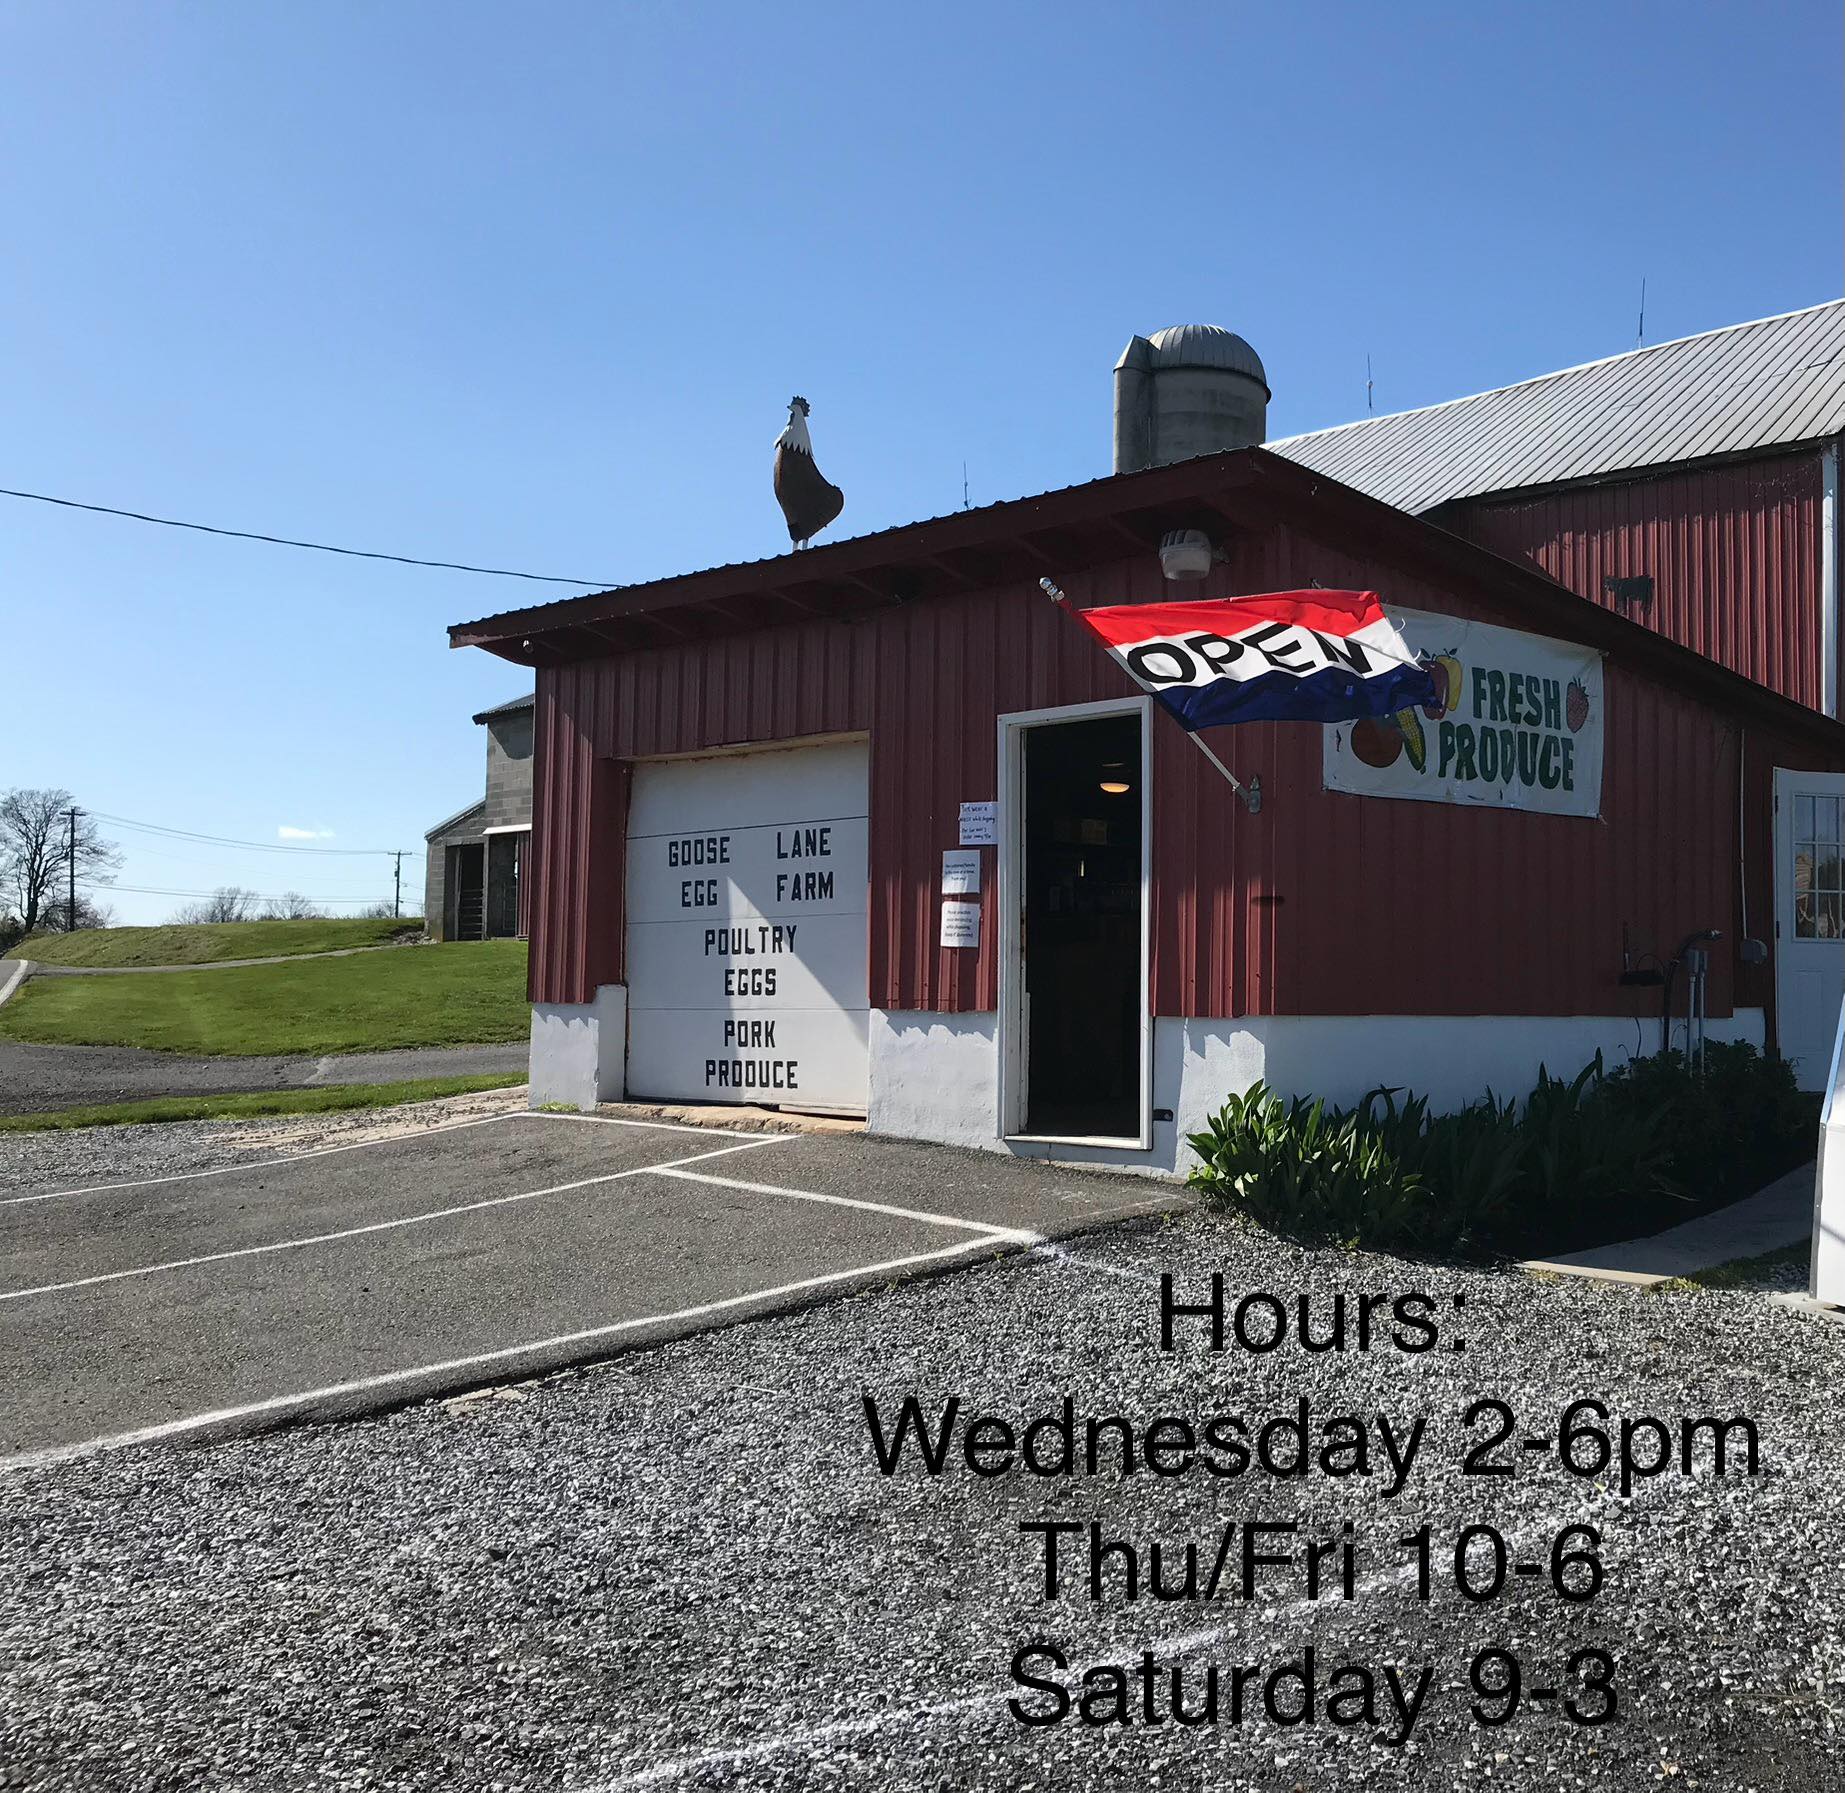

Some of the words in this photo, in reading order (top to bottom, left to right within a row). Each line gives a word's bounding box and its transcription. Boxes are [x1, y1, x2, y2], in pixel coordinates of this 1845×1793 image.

[1127, 622, 1373, 683] OPEN
[1471, 667, 1561, 730] FRESH
[1438, 721, 1574, 791] PRODUCE
[668, 836, 730, 867] GOOSE
[776, 827, 831, 859] LANE
[681, 879, 717, 907] EGG
[776, 871, 833, 902] FARM
[704, 925, 797, 956] POULTRY
[724, 968, 776, 996] EGGS
[724, 1020, 776, 1048] PORK
[705, 1059, 798, 1089] PRODUCE
